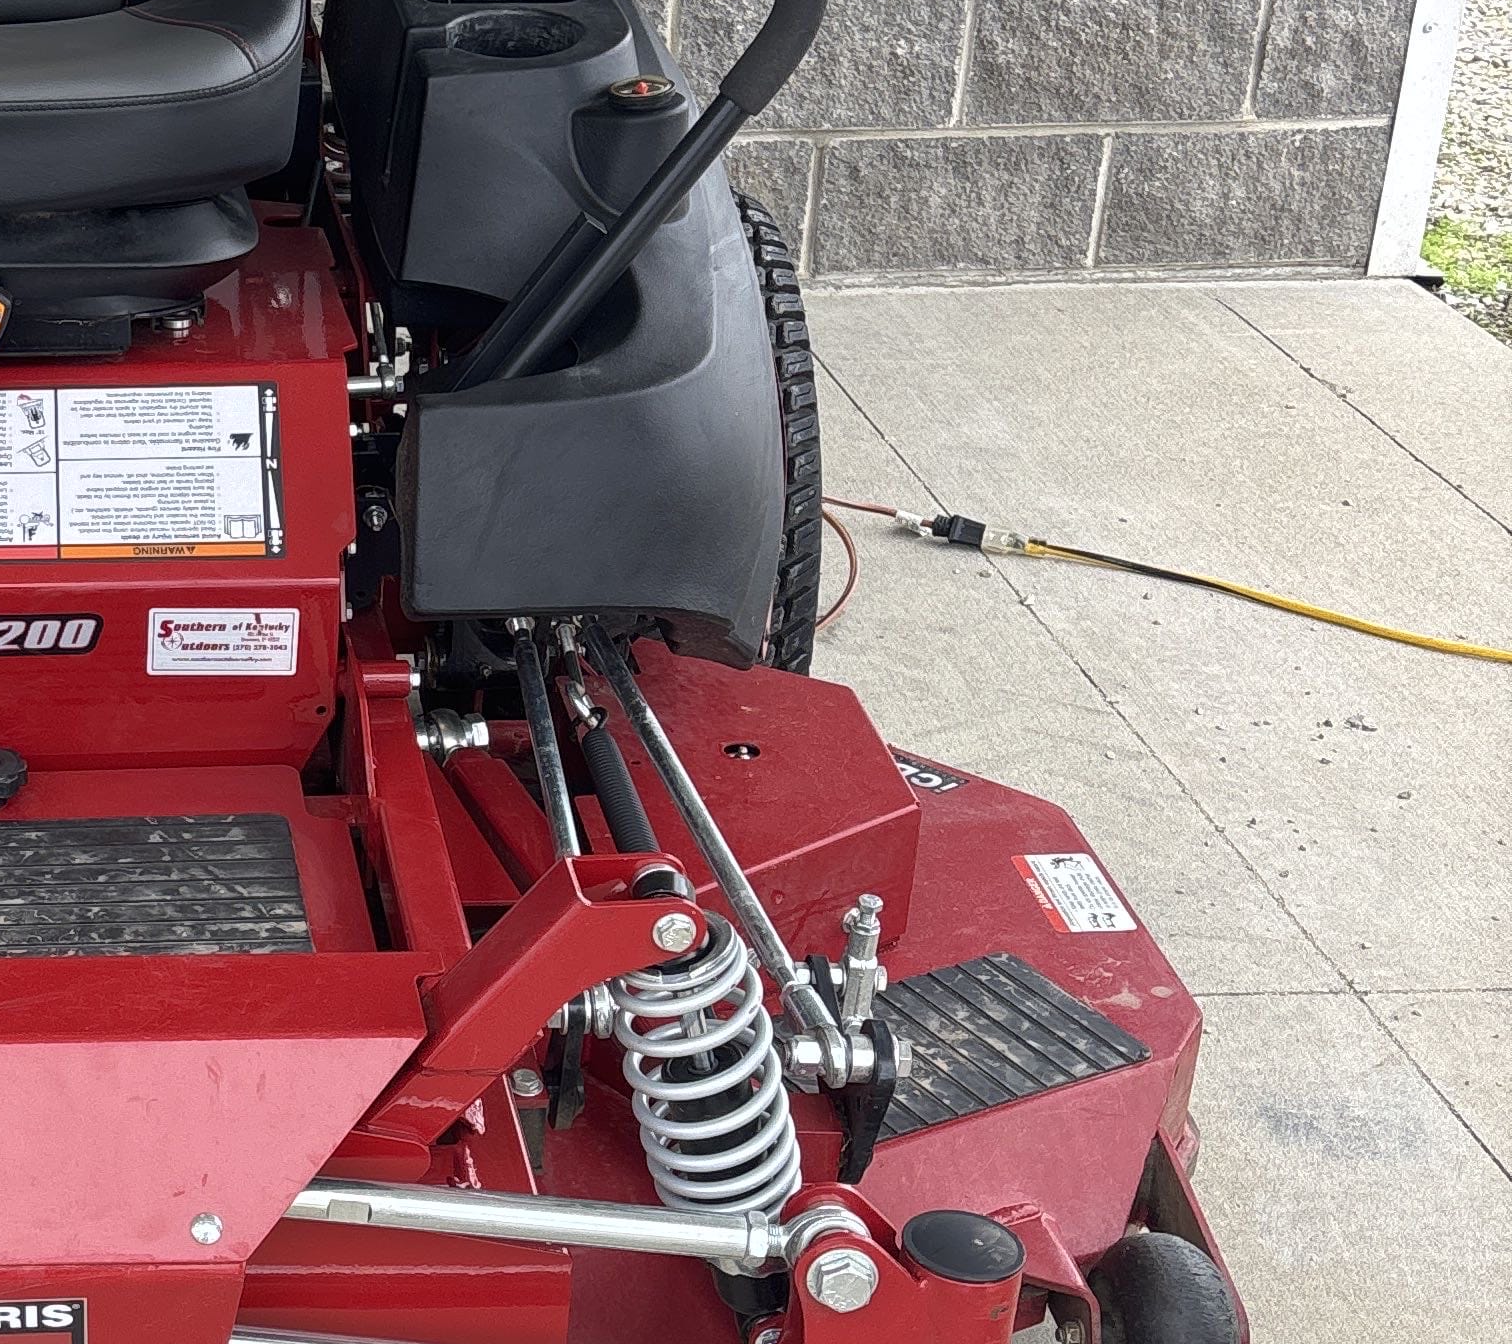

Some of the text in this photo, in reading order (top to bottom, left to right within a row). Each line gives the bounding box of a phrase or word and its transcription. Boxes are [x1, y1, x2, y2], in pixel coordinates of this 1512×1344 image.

[266, 458, 277, 469] N
[132, 546, 185, 555] WARNING
[158, 620, 227, 638] Southern
[232, 622, 244, 631] of
[1026, 878, 1048, 904] DANGER
